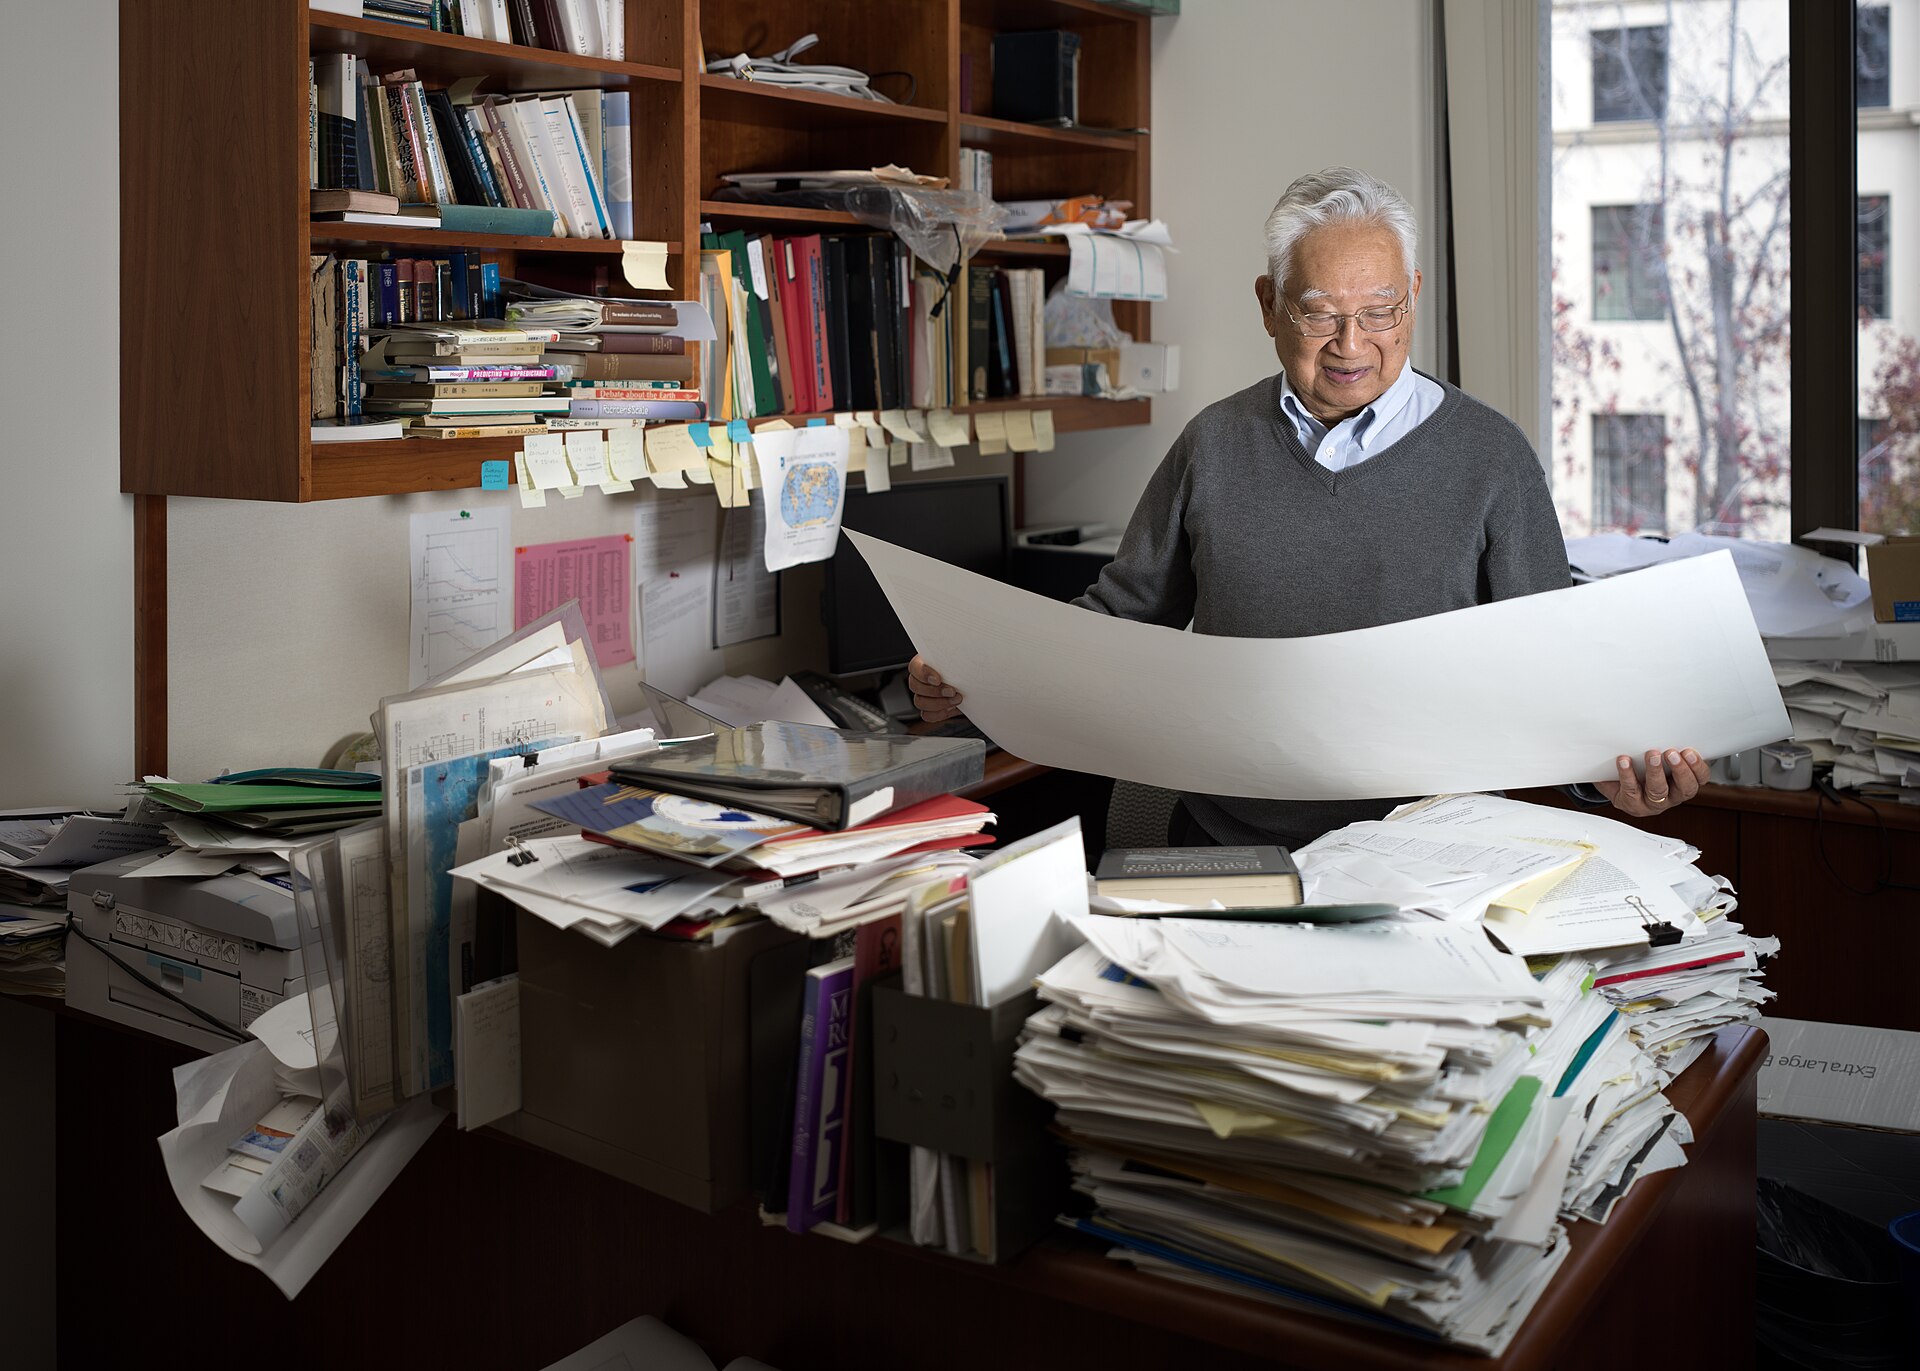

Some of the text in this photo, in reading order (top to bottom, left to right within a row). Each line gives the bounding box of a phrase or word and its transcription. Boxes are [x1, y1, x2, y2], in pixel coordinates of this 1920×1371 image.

[387, 85, 418, 184] 関東大震災
[497, 128, 523, 190] HYDRODYNAMICS
[472, 370, 503, 378] PREDICTING
[509, 370, 548, 378] UNPREDICTABLE
[600, 390, 676, 399] Debate about the Earth
[602, 404, 649, 415] Richter's Scale
[1778, 1054, 1828, 1074] Large
[1830, 1062, 1877, 1079] Extra
